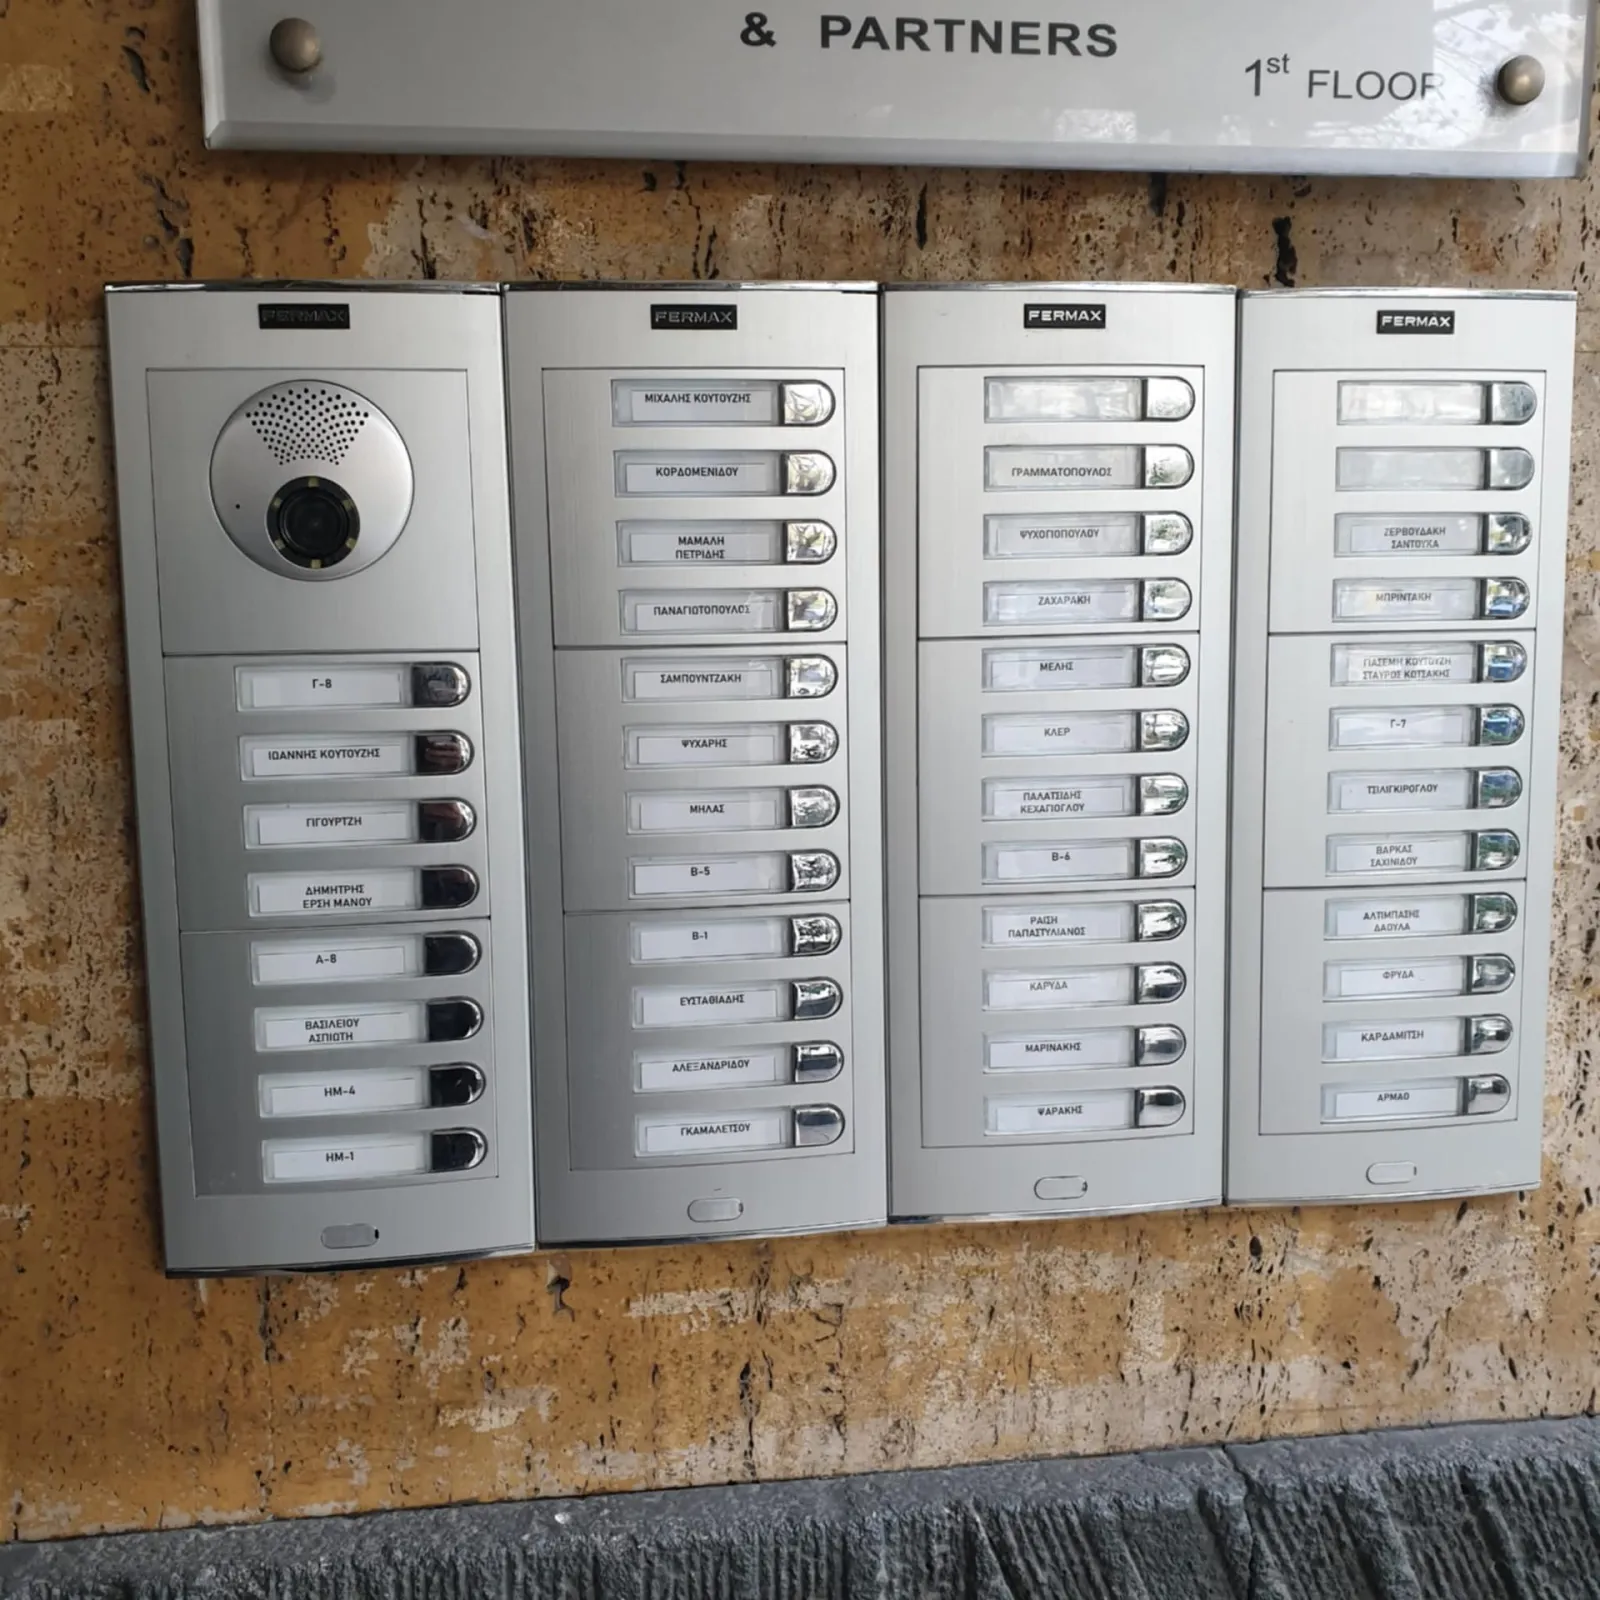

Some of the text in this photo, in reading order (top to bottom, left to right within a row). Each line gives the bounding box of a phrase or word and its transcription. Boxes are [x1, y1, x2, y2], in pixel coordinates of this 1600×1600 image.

[739, 11, 1119, 58] & PARTNERS
[654, 310, 733, 323] FERMAX
[1028, 310, 1102, 322] FERMAX
[1381, 316, 1451, 328] FERMAX
[645, 393, 751, 403] ΜΙΧΑΛΗΣ ΚΟΥΤΟΥΖΗΣ
[655, 467, 738, 477] ΚΟΡΔΟΜΕΝΙΔΟΥ
[1012, 467, 1112, 477] ΓΡΑΜΜΑΤΟΠΟΥΛΟΣ
[678, 536, 725, 546] ΜΑΜΑΛΗ
[675, 550, 726, 559] ΠΕΤΡΙΔΗΣ
[1038, 595, 1091, 605] ΖΑΧΑΡΑΚΗ
[1040, 662, 1074, 671] ΜΕΛΗΣ
[312, 678, 333, 689] Γ-8
[660, 674, 741, 684] ΣΑΜΠΟΥΝΤΖΑΚΗ
[1044, 728, 1071, 736] ΚΛΕΡ
[681, 739, 728, 748] ΨΥΧΑΡΗΣ
[268, 748, 381, 760] ΙΩΑΝΝΗΣ ΚΟΥΤΟΥΖΗΣ
[1023, 791, 1082, 801] ΠΑΛΑΤΣΙΔΗΣ
[690, 805, 725, 814] ΜΗΛΑΣ
[1376, 845, 1413, 855] ΒΑΡΚΑΣ
[1371, 857, 1418, 867] ΣΑΧΙΝΙΔΟΥ
[305, 884, 365, 895] ΔΗΜΗΤΡΗΣ
[303, 897, 373, 909] ΕΡΣΗ ΜΑΝΟΥ
[1374, 923, 1411, 932] ΔΑΟΥΛΑ
[1383, 970, 1414, 980] ΦΡΥΔΑ
[1030, 981, 1068, 991] ΚΑΡΥΔΑ
[680, 995, 745, 1006] ΕΥΣΤΑΘΙΑΔΗΣ
[305, 1018, 360, 1030] ΒΑΣΙΛΕΙΟΥ
[309, 1032, 354, 1043] ΑΣΠΙΩΤΗ
[1361, 1031, 1424, 1042] ΚΑΡΔΑΜΙΤΣΗ
[1025, 1042, 1082, 1052] ΜΑΡΙΝΑΚΗΣ
[672, 1060, 750, 1072] ΑΛΕΞΑΝΔΡΙΔΟΥ
[1377, 1092, 1410, 1102] ΑΡΜΑΟ
[1037, 1106, 1083, 1116] ΨΑΡΑΚΗΣ
[681, 1123, 751, 1136] ΓΚΑΜΑΛΕΤΣΟΥ
